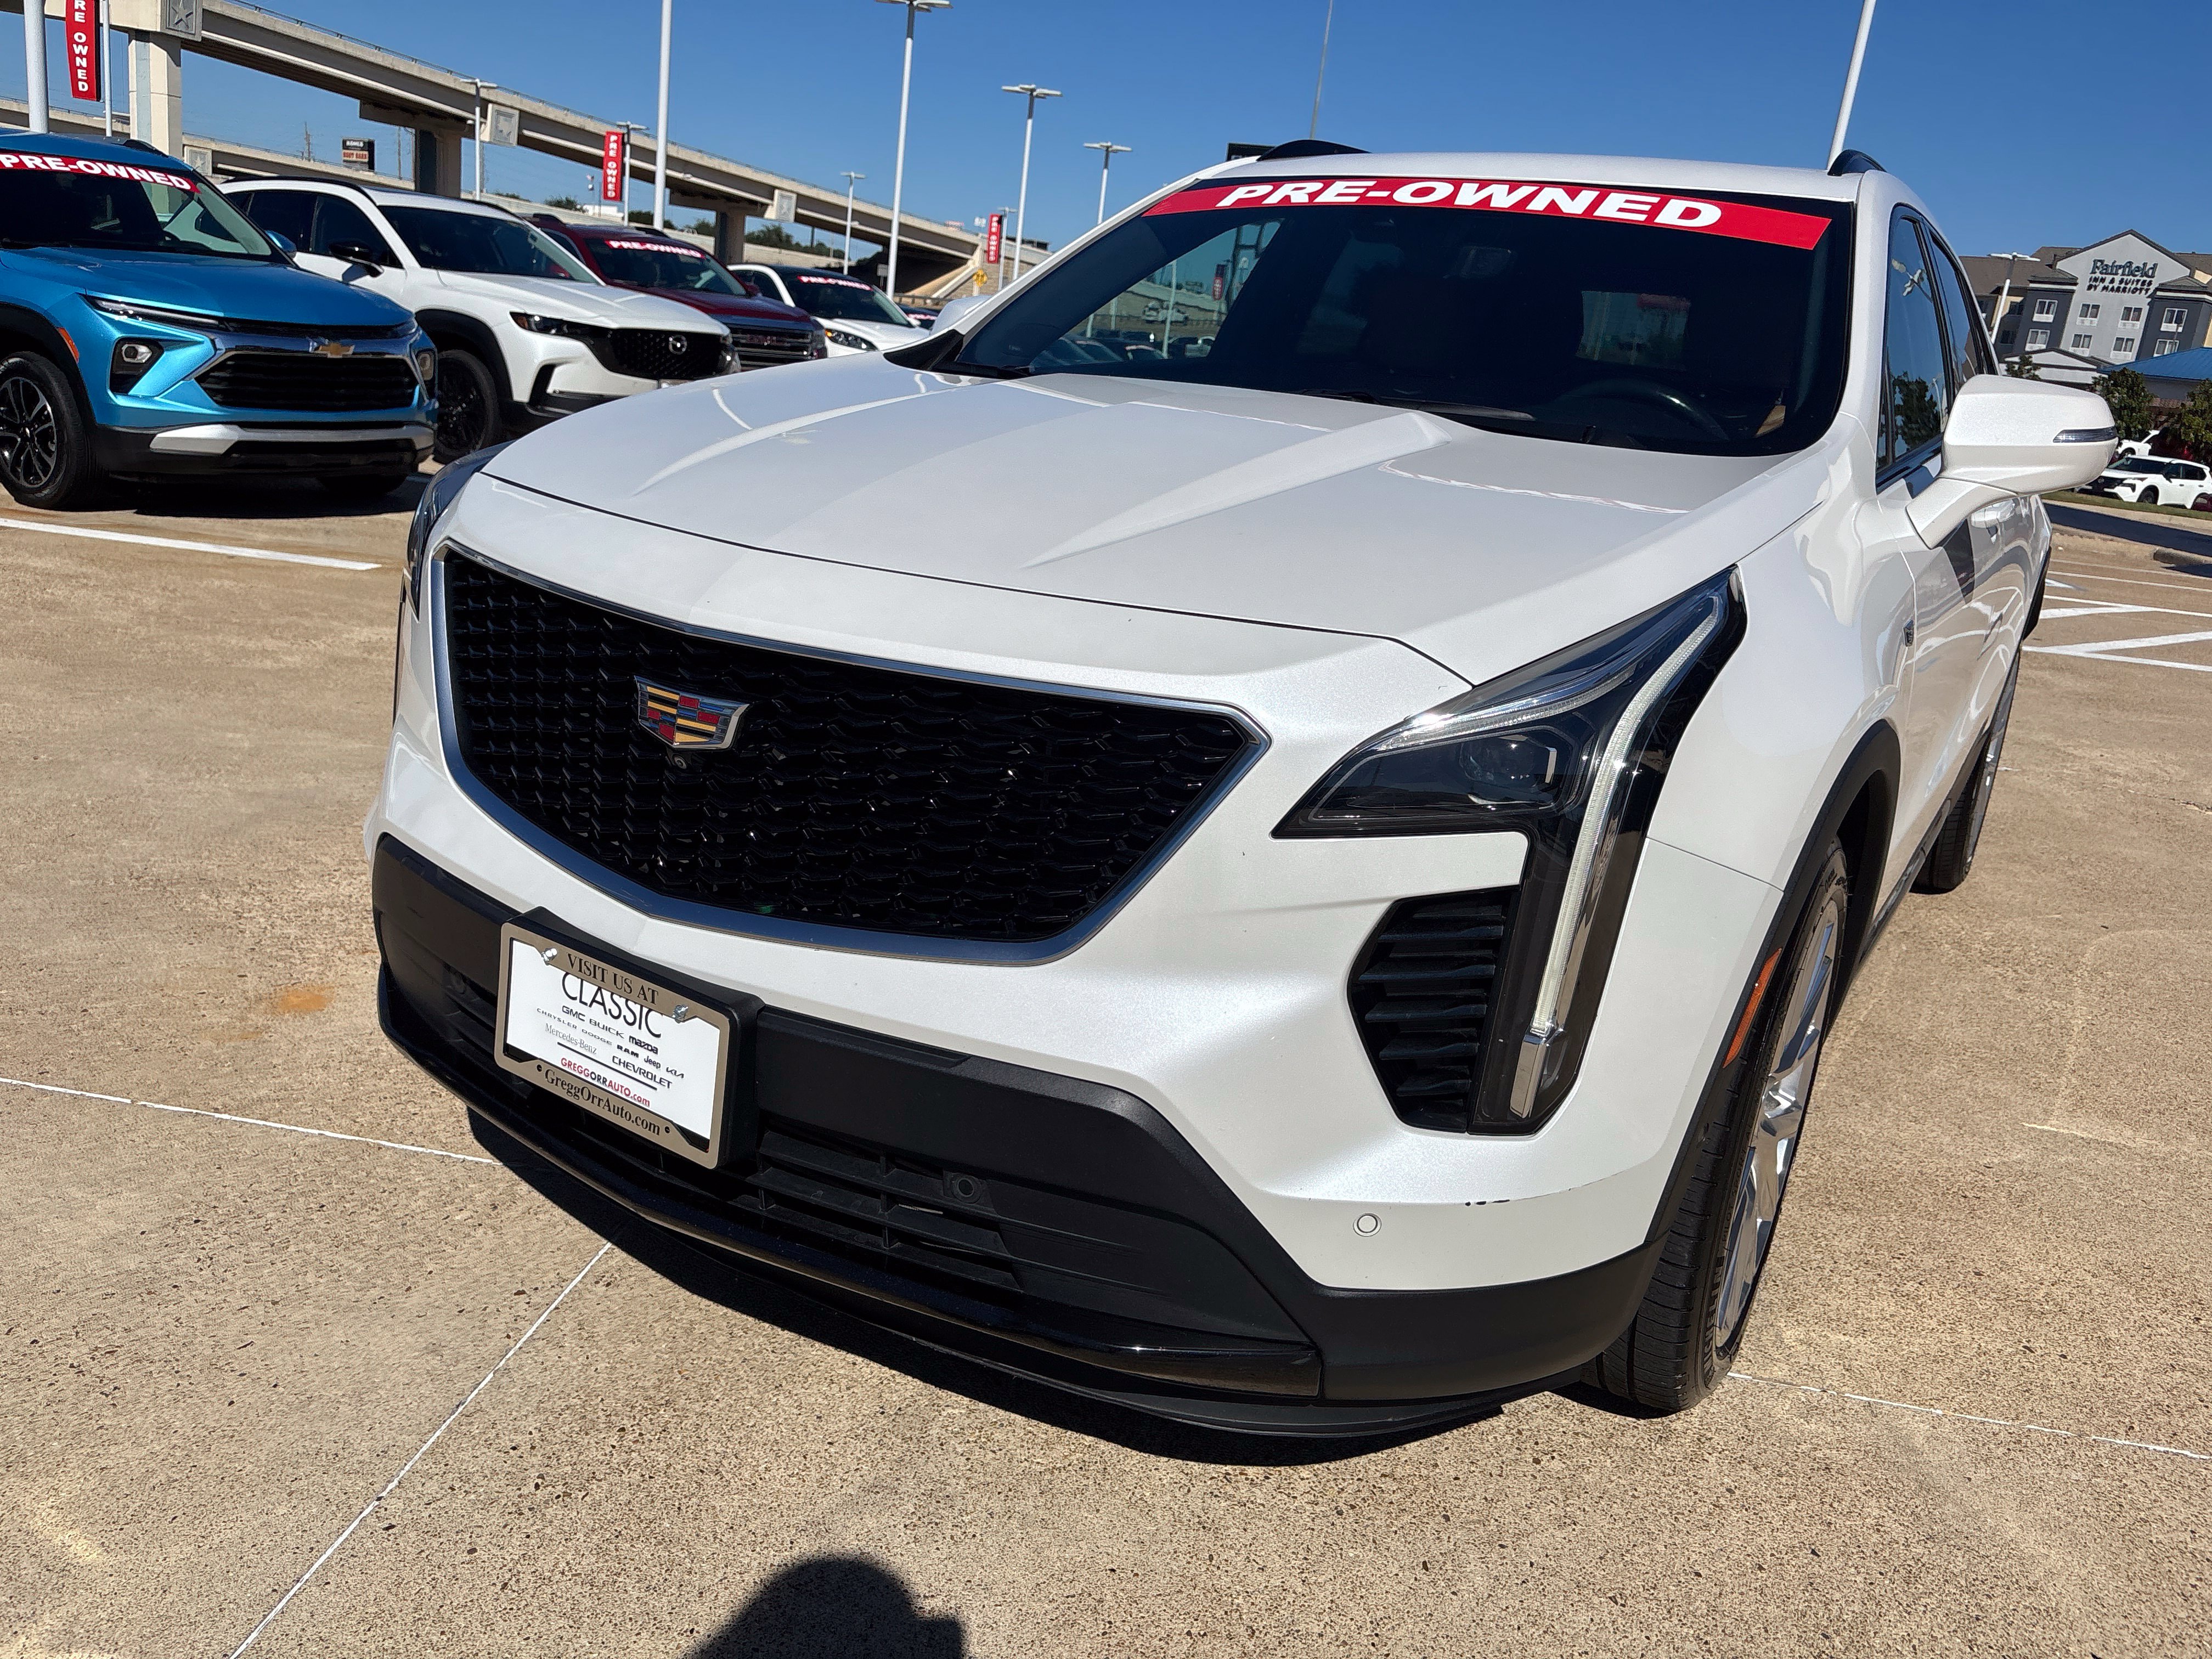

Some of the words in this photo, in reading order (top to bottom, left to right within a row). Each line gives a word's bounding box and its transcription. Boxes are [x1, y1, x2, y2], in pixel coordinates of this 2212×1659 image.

[72, 32, 89, 92] OWNED
[608, 135, 618, 157] PRE
[0, 154, 191, 190] PRE-OWNED
[606, 161, 618, 198] OWNED
[1215, 180, 1722, 228] PRE-OWNED
[2089, 259, 2158, 278] Fairfield
[2101, 285, 2150, 295] MARRIOTT
[2118, 278, 2153, 287] SUITES
[567, 952, 608, 984] VISIT
[613, 972, 633, 994] US
[637, 985, 659, 1005] AT
[562, 972, 662, 1038] CLASSIC
[562, 1005, 586, 1022] GMC
[589, 1018, 624, 1039] BUICK
[537, 1008, 577, 1030] CHRYSLER
[582, 1029, 612, 1046] DODGE
[617, 1045, 639, 1058] RAM
[644, 1056, 661, 1069] Jeep
[545, 1023, 597, 1055] Mercedes-Benz
[612, 1056, 673, 1089] CHEVROLET
[545, 1069, 661, 1136] GreggOrrAuto.com
[561, 1057, 650, 1107] GREGGORRAUTO.com
[1703, 1269, 1722, 1372] MICHELIN
